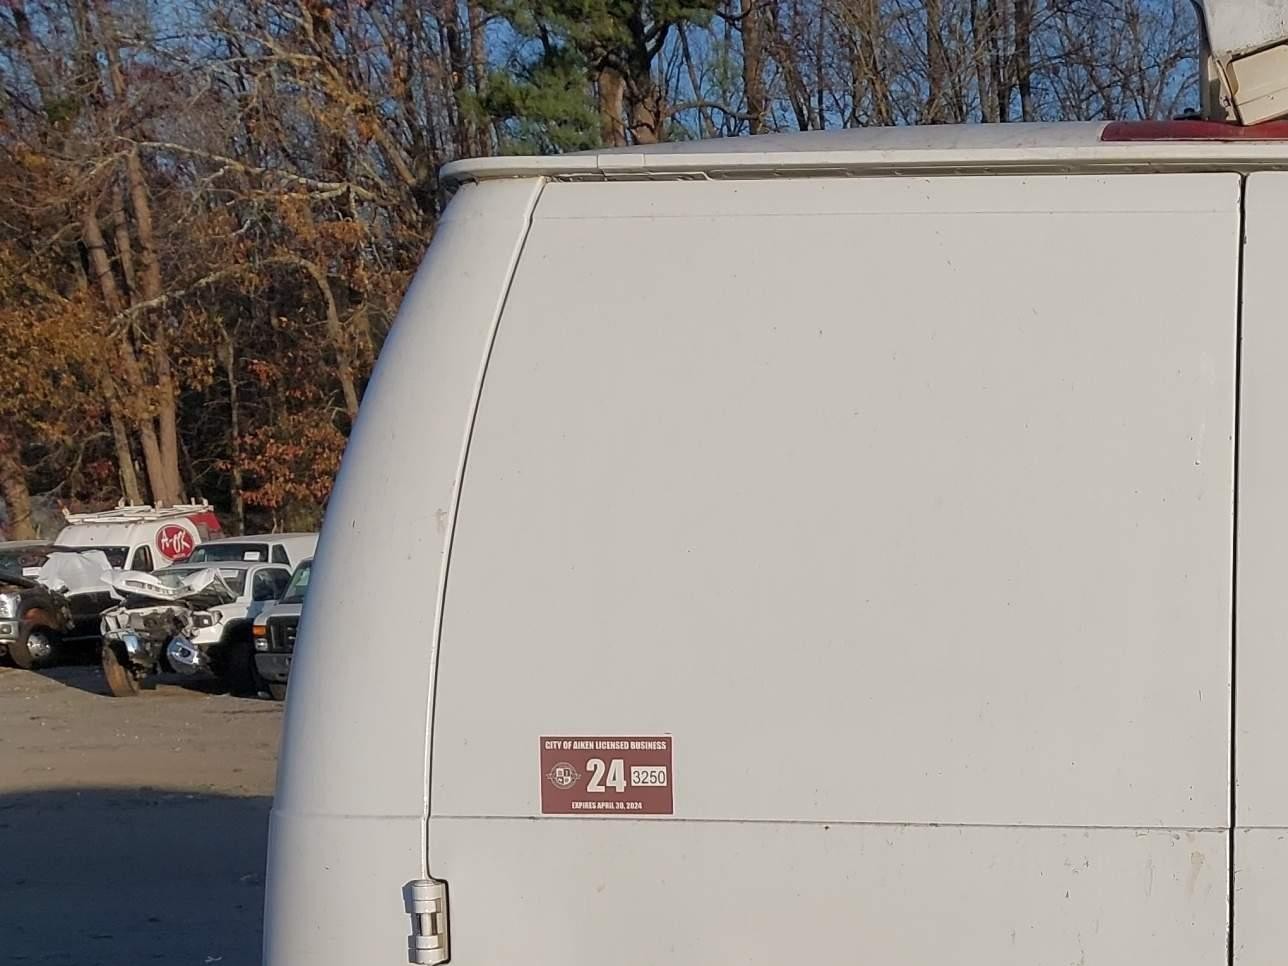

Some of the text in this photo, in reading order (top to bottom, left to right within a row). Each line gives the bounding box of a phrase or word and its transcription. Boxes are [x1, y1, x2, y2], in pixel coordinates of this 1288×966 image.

[545, 740, 667, 750] CITY OF AIKEN LICENSED BUSINESS
[586, 758, 627, 793] 24
[632, 770, 666, 784] 3250
[571, 801, 596, 809] EXPIRES
[597, 801, 614, 809] APRIL
[626, 801, 642, 810] 2024
